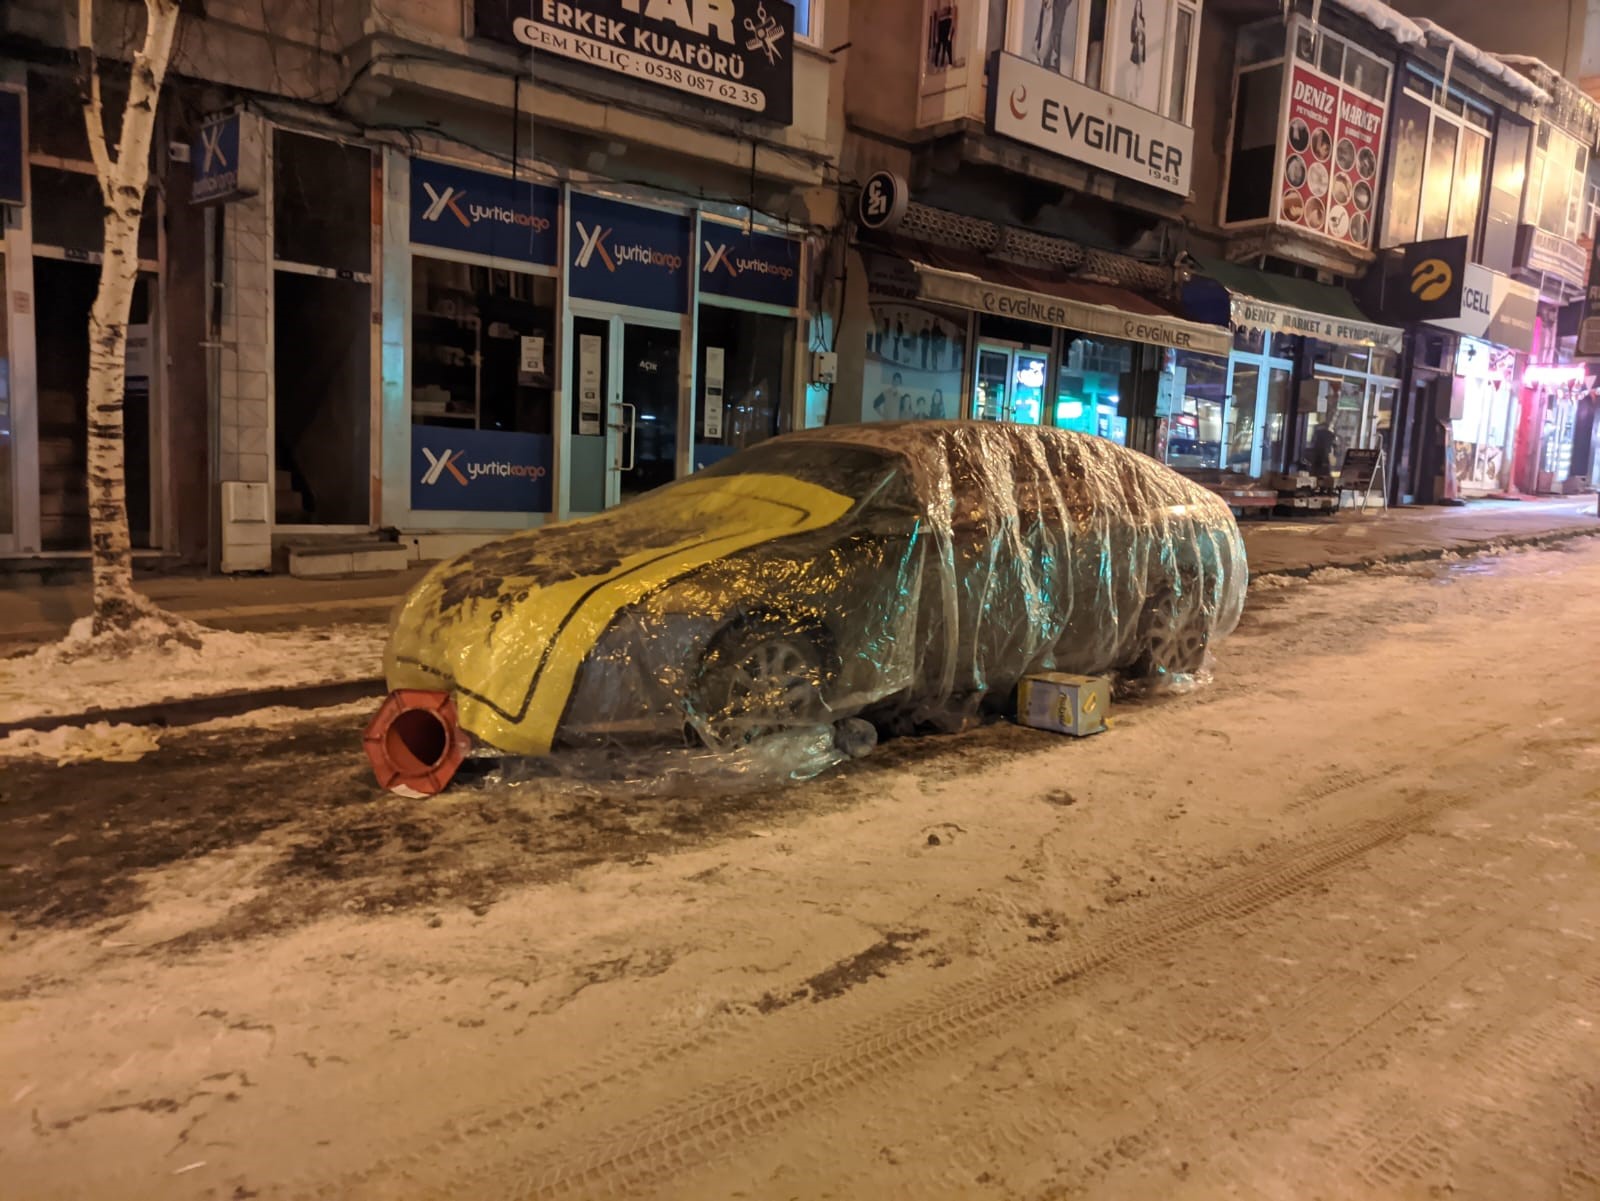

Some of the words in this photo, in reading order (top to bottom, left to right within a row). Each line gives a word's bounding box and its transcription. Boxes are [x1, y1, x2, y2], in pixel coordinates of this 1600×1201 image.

[541, 0, 627, 45] ERKEK
[633, 27, 745, 80] KUAFÖRÜ
[621, 0, 736, 45] AR
[523, 24, 568, 50] CEM
[574, 38, 630, 71] KILIÇ
[645, 62, 683, 84] 0538
[686, 74, 714, 93] 087
[719, 84, 737, 100] 62
[741, 91, 759, 106] 35
[1293, 79, 1335, 115] DENİZ
[1341, 100, 1381, 134] MARKET
[1148, 168, 1180, 186] 1943
[867, 195, 887, 215] 21
[1282, 313, 1320, 333] MARKET
